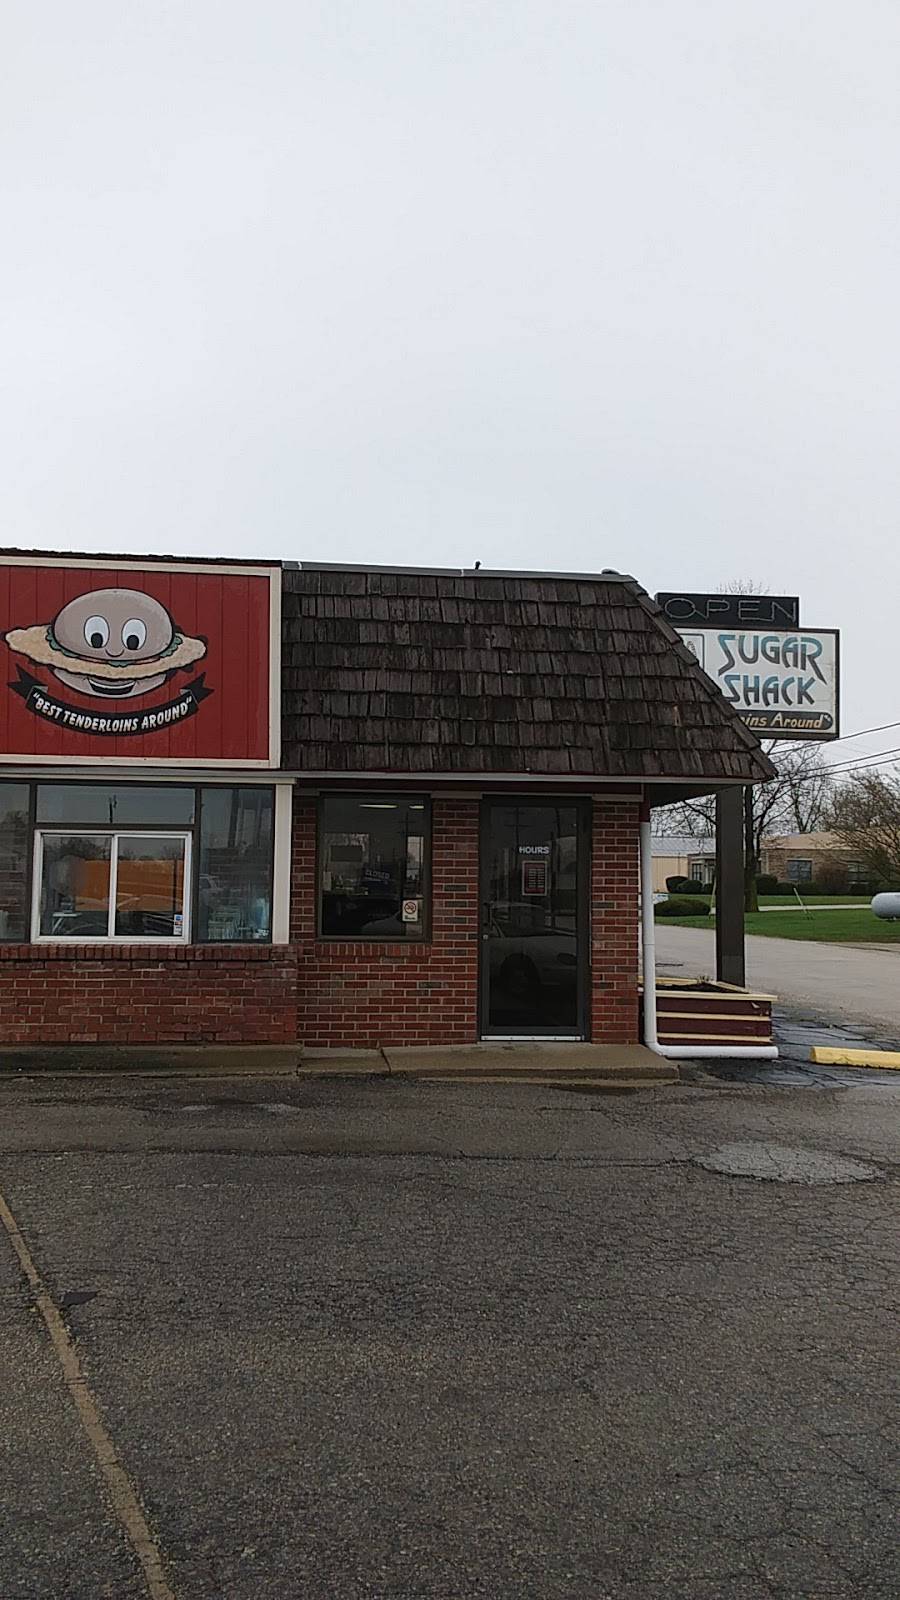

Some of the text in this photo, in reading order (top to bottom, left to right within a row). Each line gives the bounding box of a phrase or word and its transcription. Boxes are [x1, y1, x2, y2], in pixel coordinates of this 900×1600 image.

[664, 598, 796, 623] OPEN
[718, 634, 827, 685] SUGAR
[723, 674, 816, 707] SHACK
[63, 710, 138, 733] TENDERLOINS
[518, 846, 550, 855] HOURS
